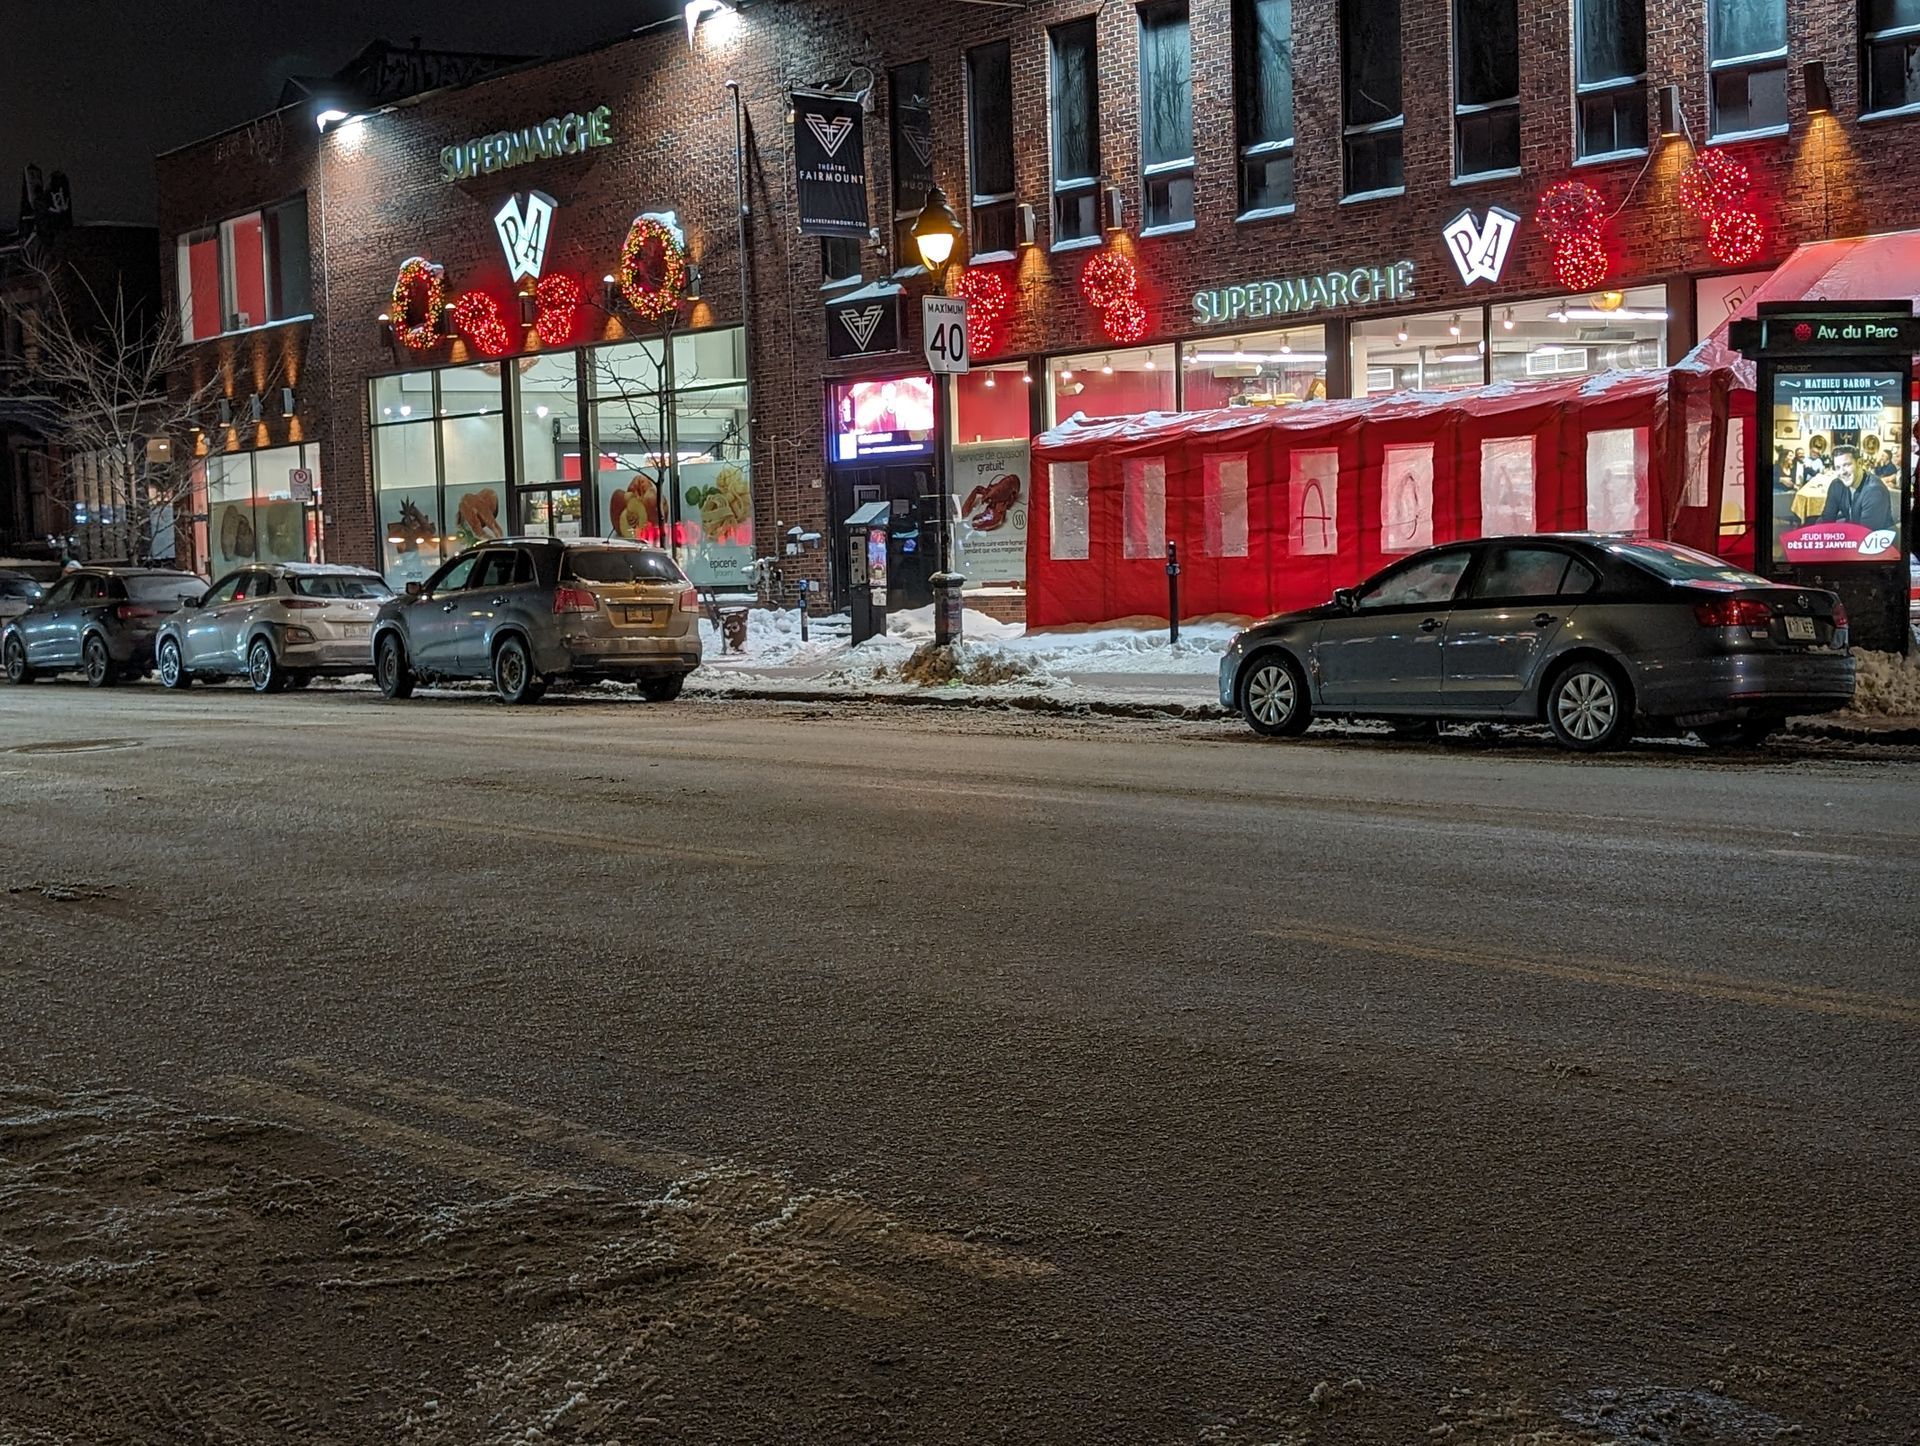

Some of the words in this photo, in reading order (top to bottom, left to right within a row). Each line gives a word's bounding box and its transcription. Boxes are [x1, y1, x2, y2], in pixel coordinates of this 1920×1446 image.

[800, 170, 864, 185] FAIRMOUNT
[927, 303, 963, 315] MAXIMUM
[1817, 325, 1839, 339] Av.
[1842, 325, 1862, 339] du
[1865, 324, 1899, 338] Parc
[930, 323, 964, 362] 40
[1804, 378, 1841, 389] MATHIEU
[1843, 378, 1871, 388] BARON
[1791, 395, 1884, 412] RETROUVAILLES
[1809, 414, 1878, 430] L'ITALIENNE
[1787, 540, 1803, 549] DÈS
[1804, 541, 1813, 549] LE
[1814, 541, 1824, 549] 25
[1825, 541, 1858, 549] JANVIER
[1800, 533, 1822, 541] JEUDI
[1863, 533, 1890, 549] vie
